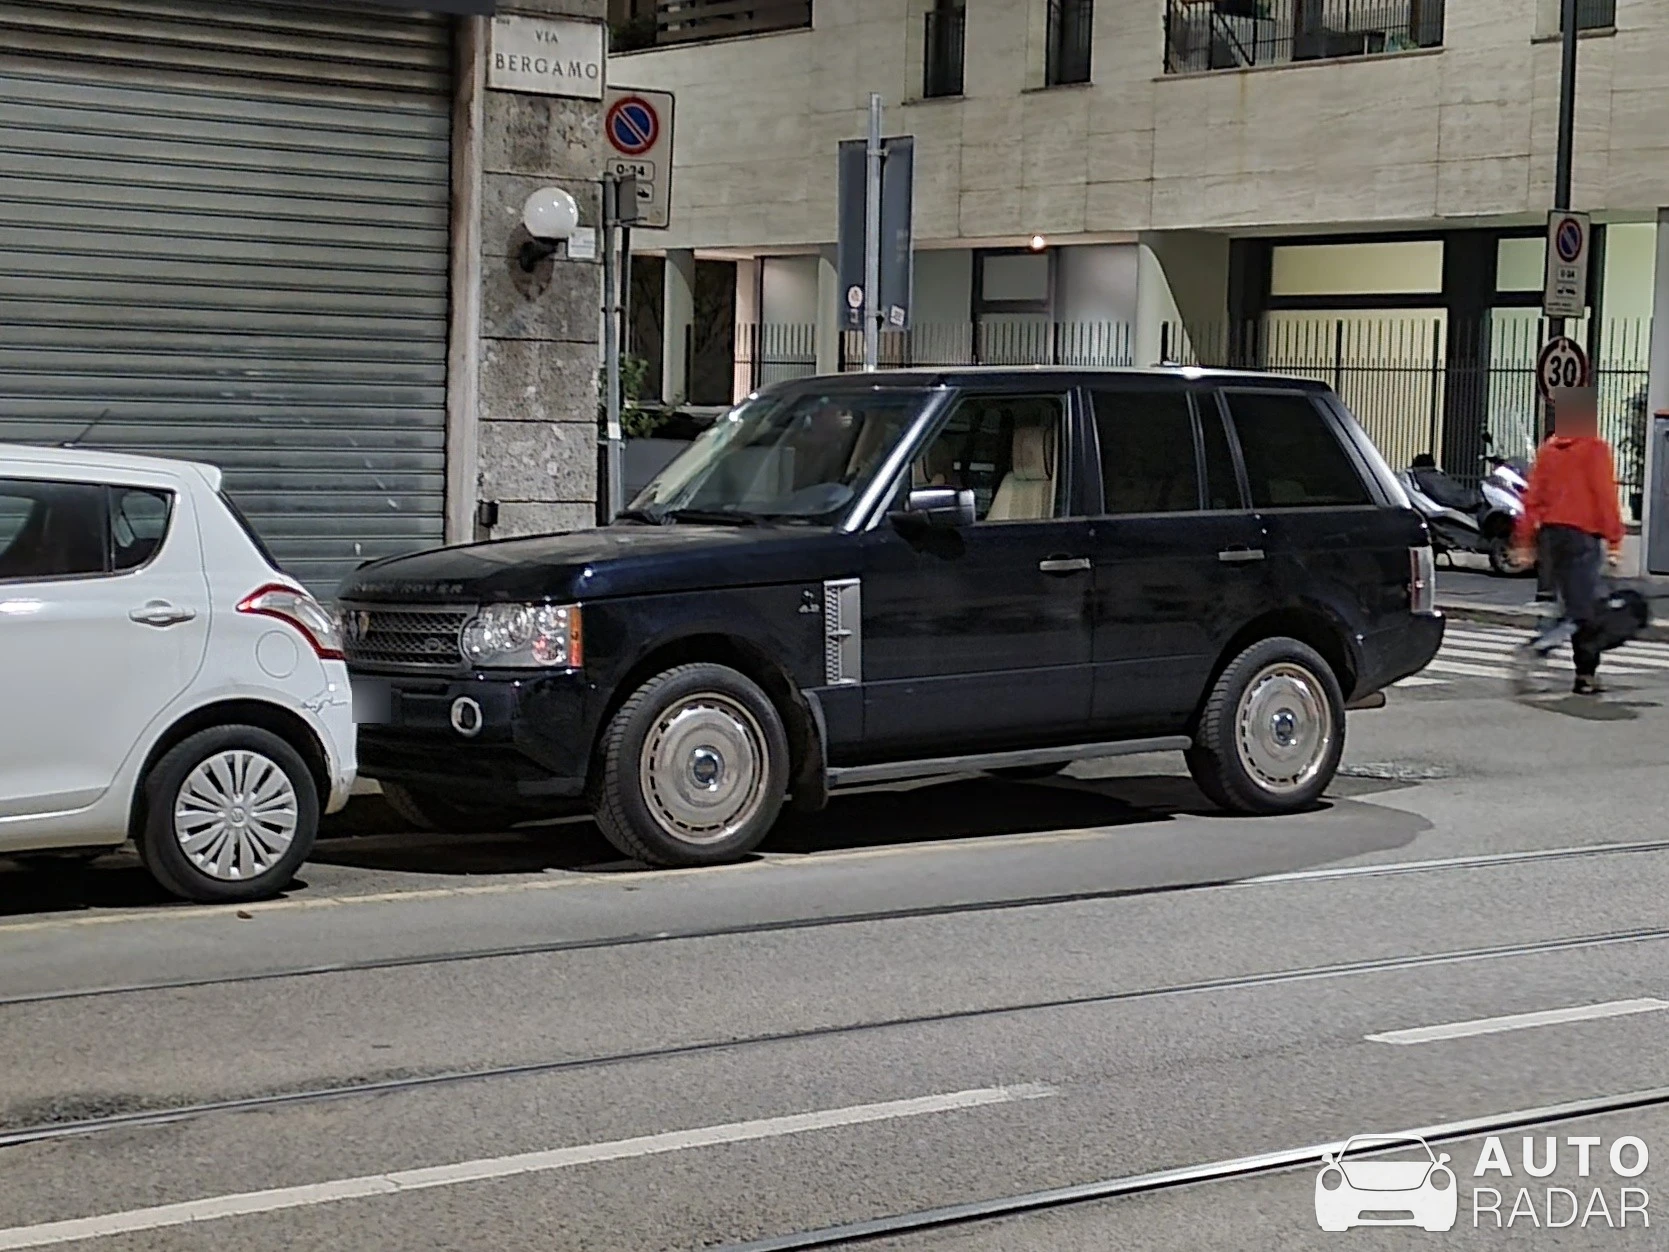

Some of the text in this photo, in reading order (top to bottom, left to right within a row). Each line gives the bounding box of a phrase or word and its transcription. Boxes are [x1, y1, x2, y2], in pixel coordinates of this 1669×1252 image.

[535, 30, 558, 44] VIA
[495, 53, 599, 79] BERGAMO
[1549, 355, 1577, 387] 30
